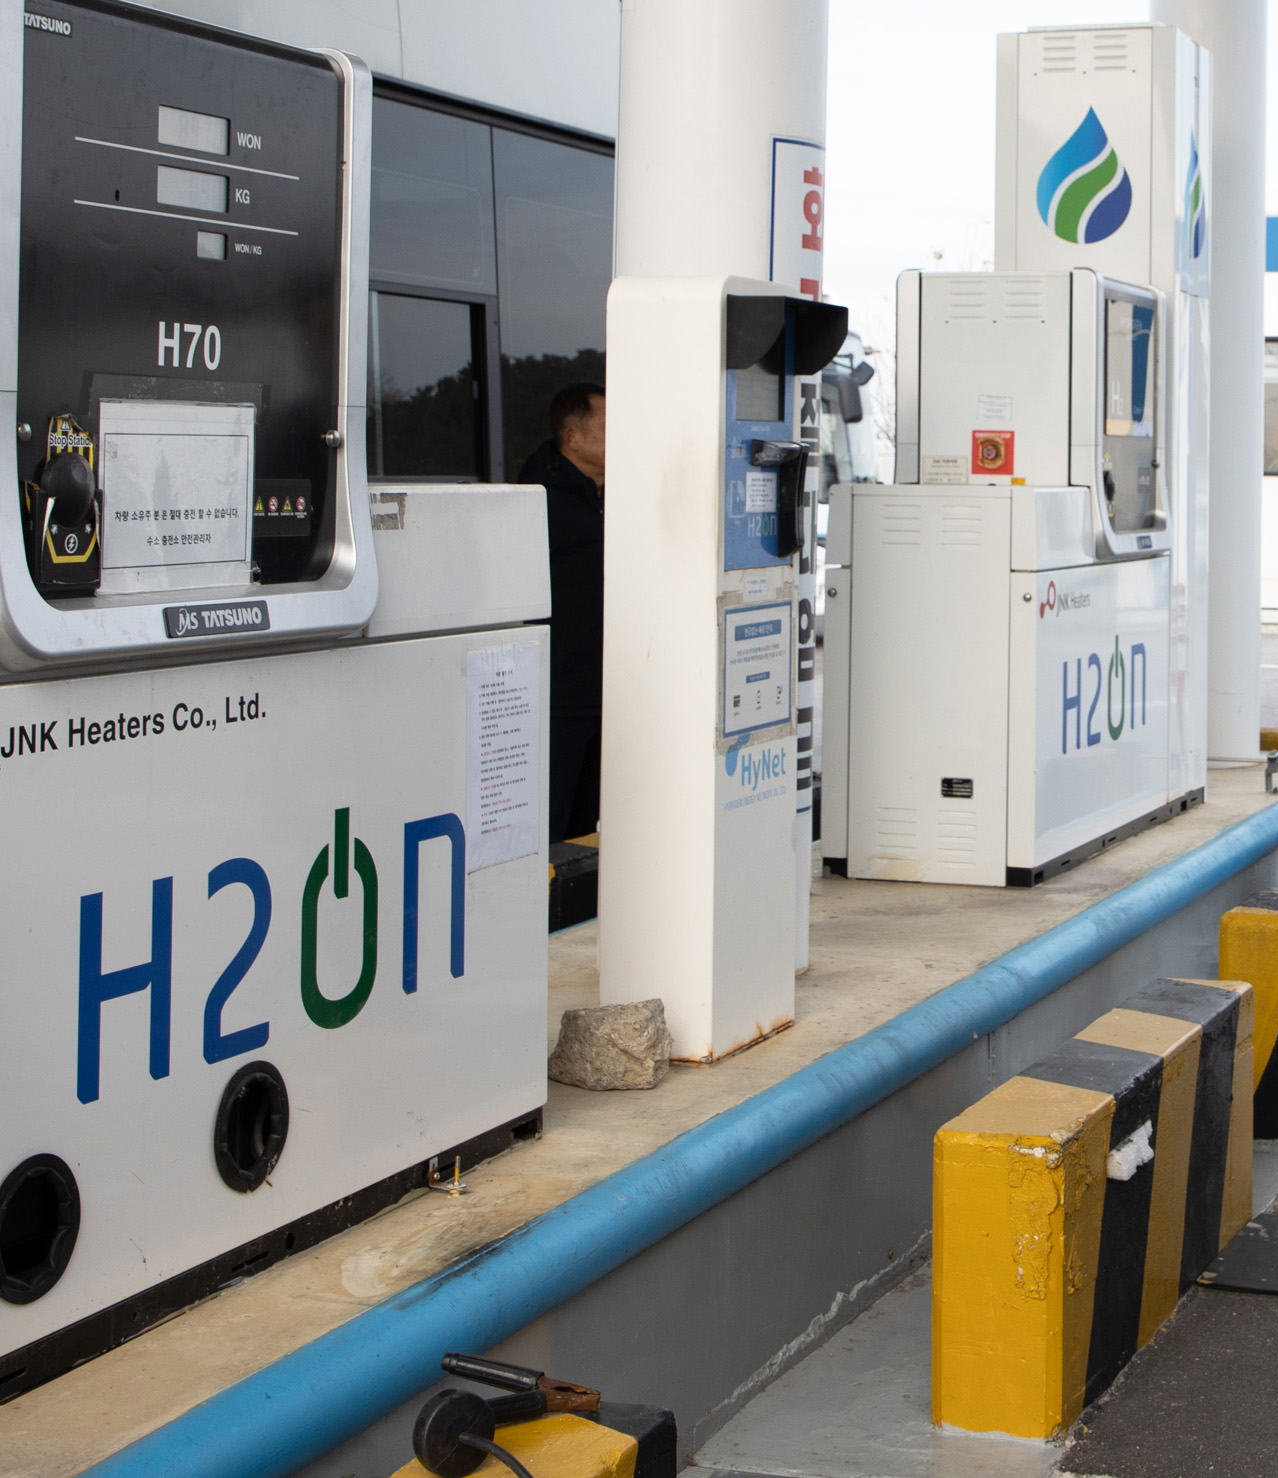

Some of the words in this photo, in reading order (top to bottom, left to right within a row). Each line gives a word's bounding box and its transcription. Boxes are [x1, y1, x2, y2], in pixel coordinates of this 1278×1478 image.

[24, 12, 71, 35] TATSUNO
[237, 131, 262, 150] WON
[235, 188, 251, 205] KG
[157, 320, 222, 370] H70
[49, 432, 67, 449] Stop
[114, 510, 129, 522] 차량
[146, 535, 160, 547] 수소
[161, 534, 179, 546] 충전소
[180, 533, 212, 546] 안전관리자
[201, 606, 263, 628] TATSUNO
[0, 720, 59, 759] JNK
[68, 709, 165, 748] Heaters
[172, 702, 217, 732] Co.,
[224, 692, 267, 725] Ltd.
[741, 746, 786, 792] HyNet
